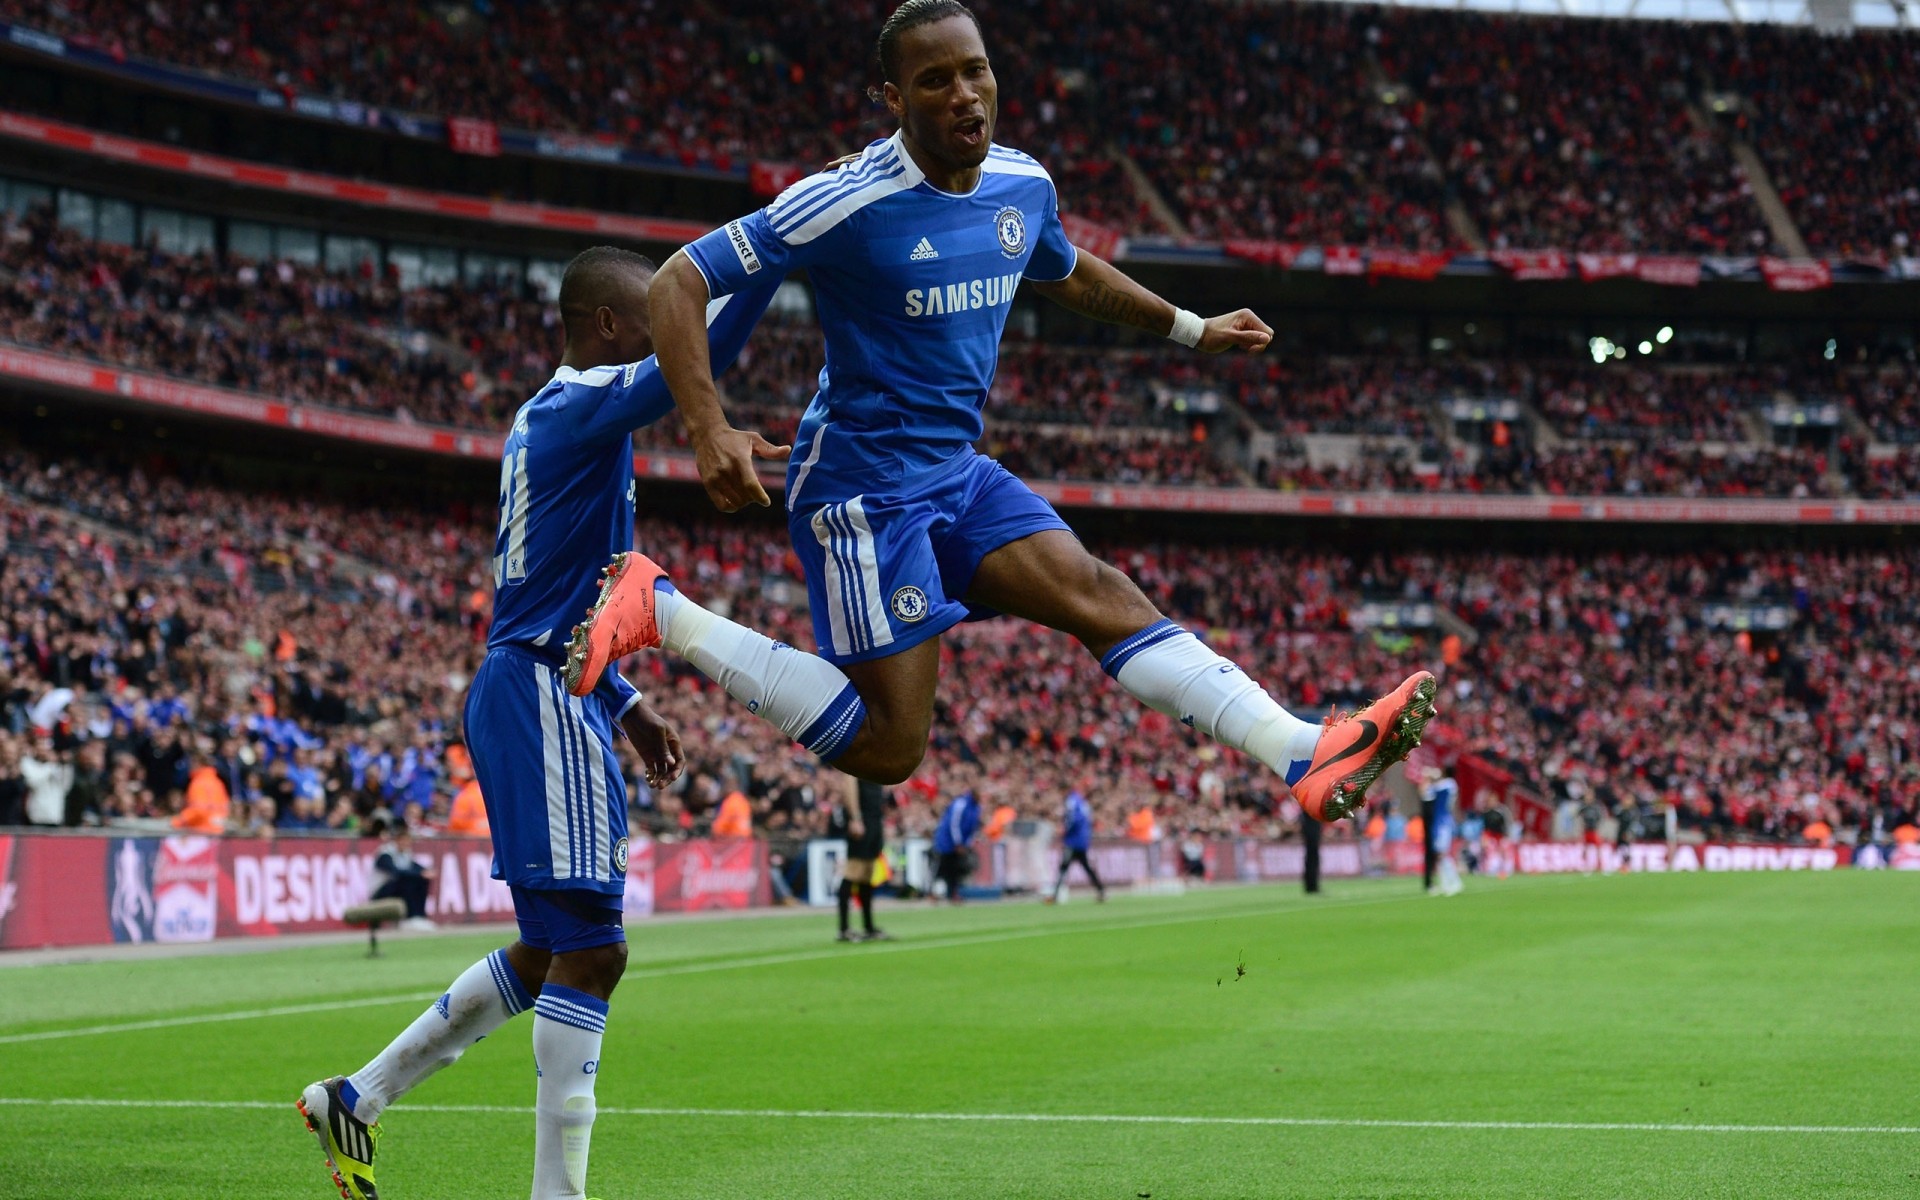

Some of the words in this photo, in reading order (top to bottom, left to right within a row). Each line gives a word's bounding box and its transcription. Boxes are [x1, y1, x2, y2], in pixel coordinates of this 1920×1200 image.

[729, 220, 753, 260] Respect
[910, 250, 939, 260] adidas
[1704, 844, 1838, 872] DRIVER
